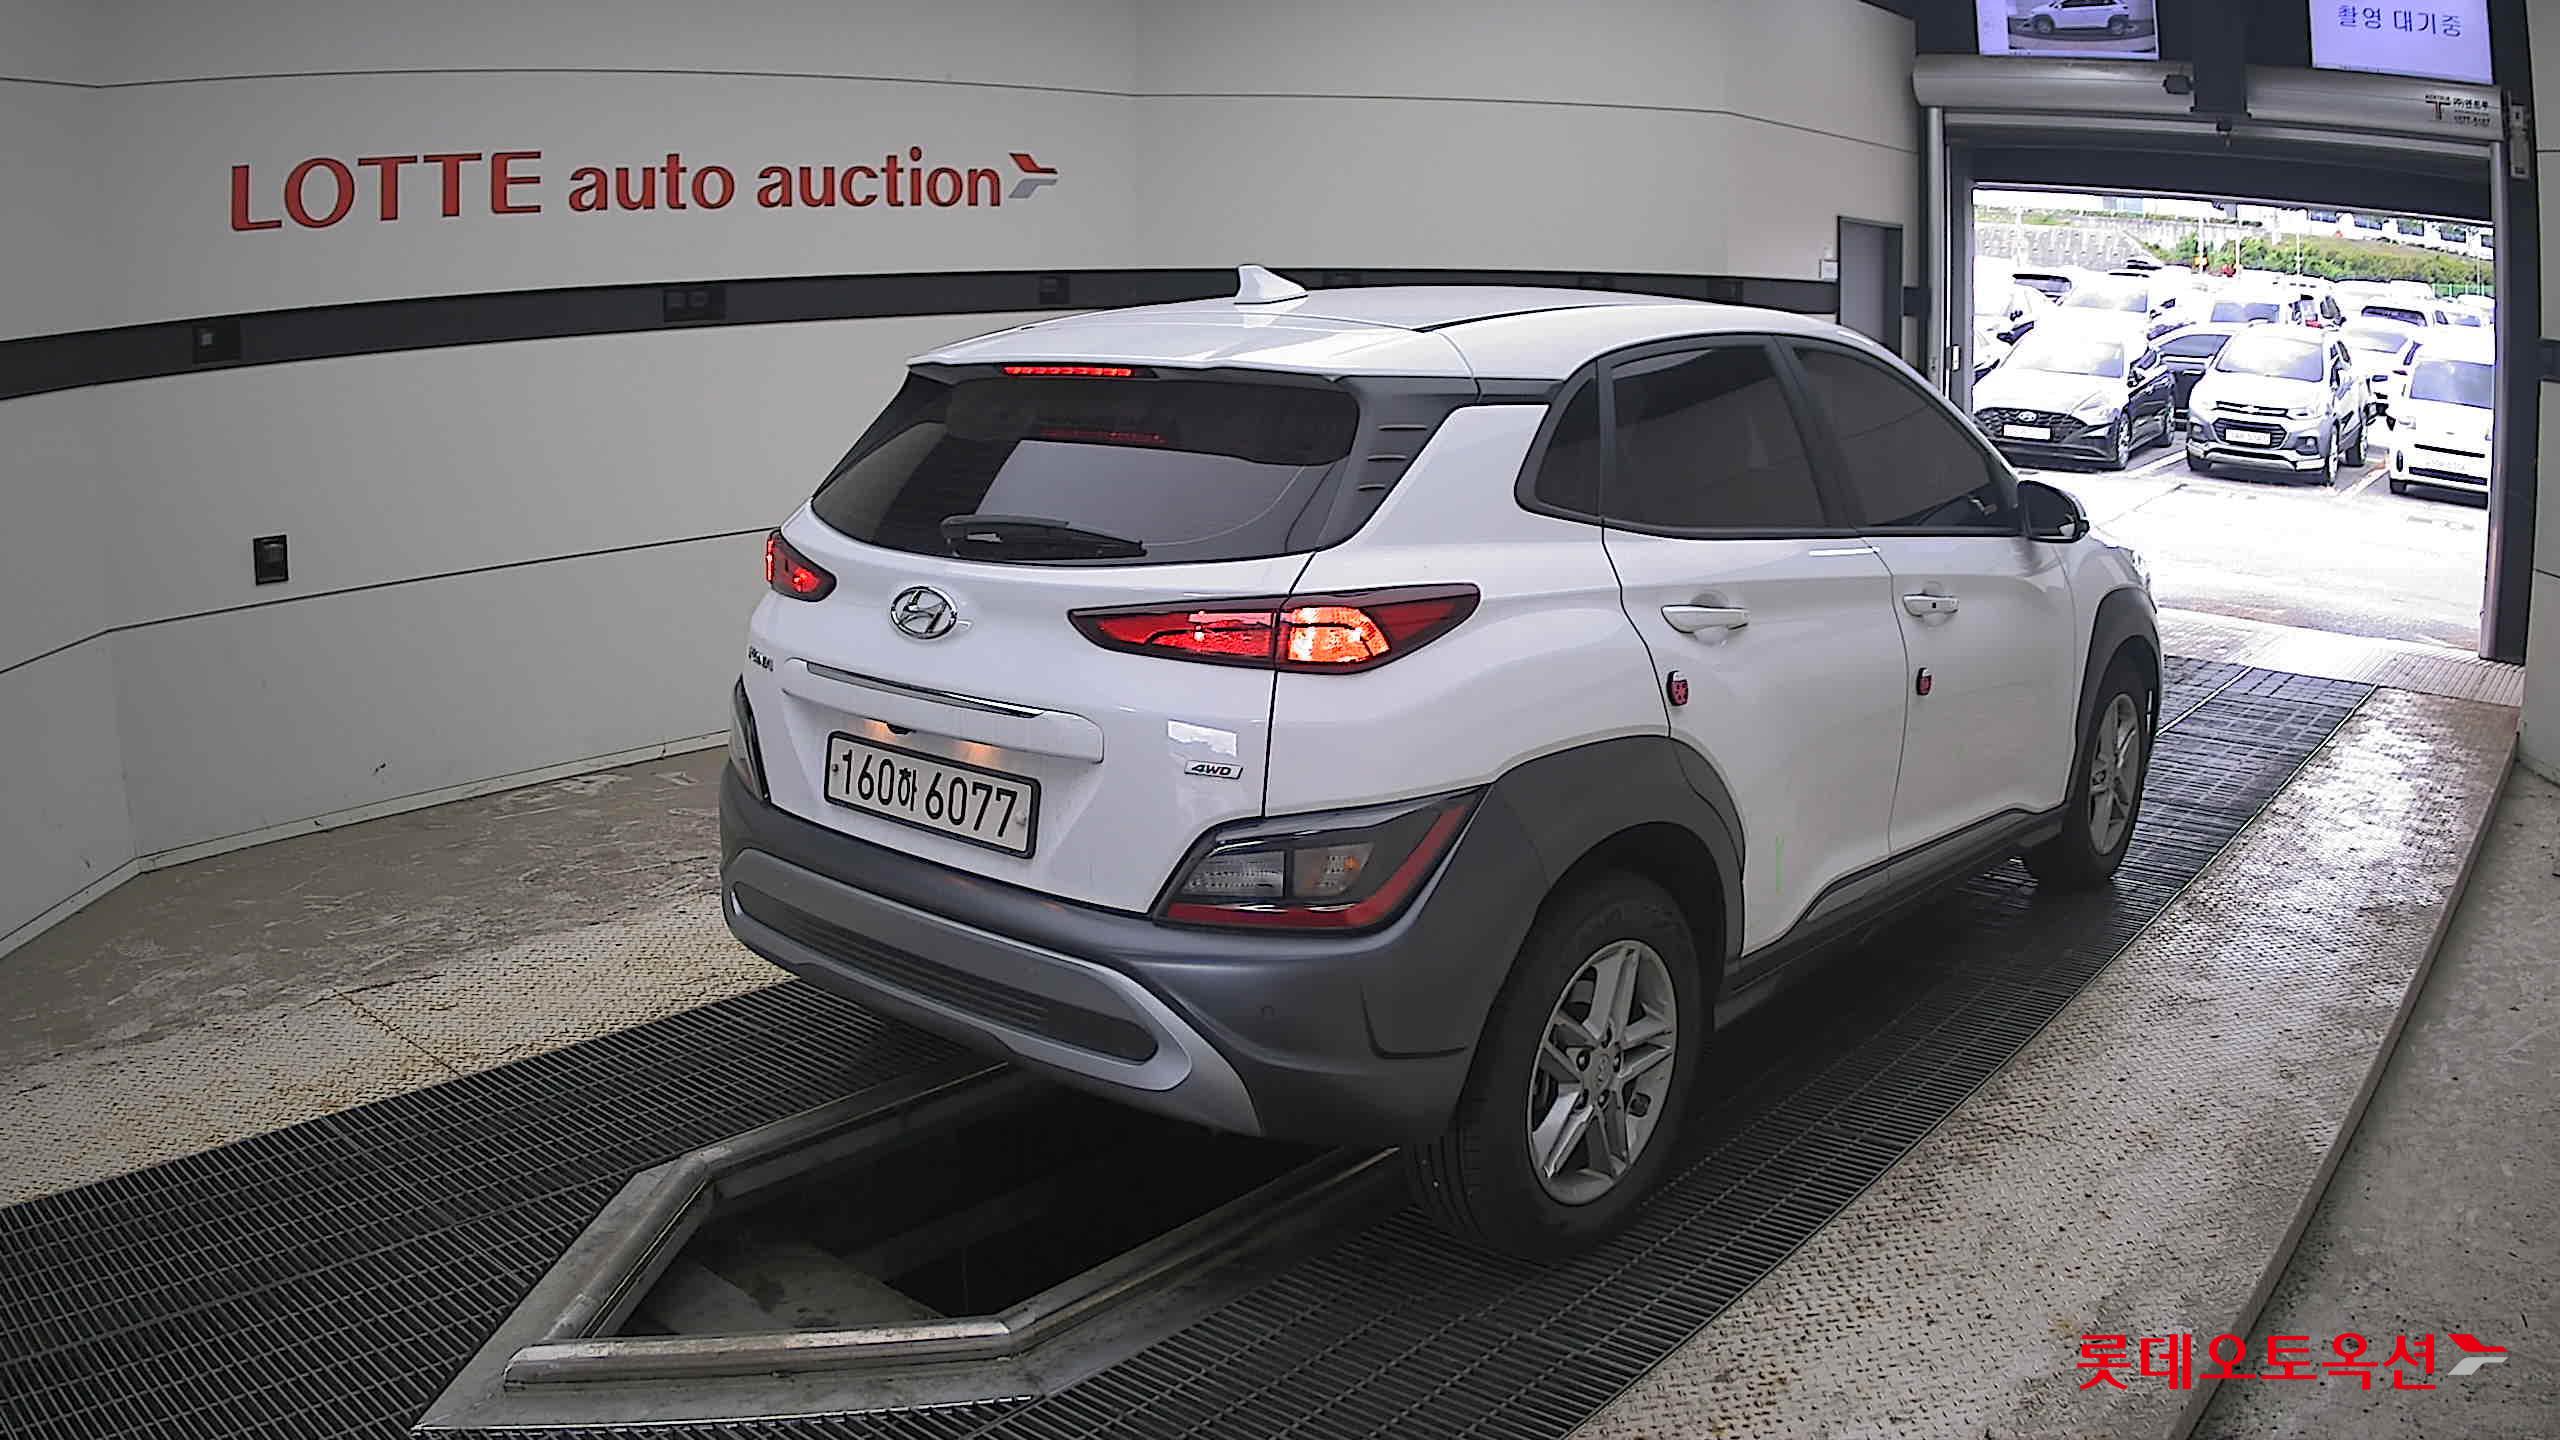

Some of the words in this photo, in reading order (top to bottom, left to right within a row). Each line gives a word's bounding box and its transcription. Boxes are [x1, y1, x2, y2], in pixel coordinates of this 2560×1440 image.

[2393, 10, 2461, 37] 대기중
[230, 151, 542, 232] LOTTE
[568, 154, 735, 211] auto
[756, 146, 1001, 208] auction
[842, 749, 917, 811] 160하
[925, 772, 1018, 837] 6077
[1191, 764, 1232, 776] 4WD
